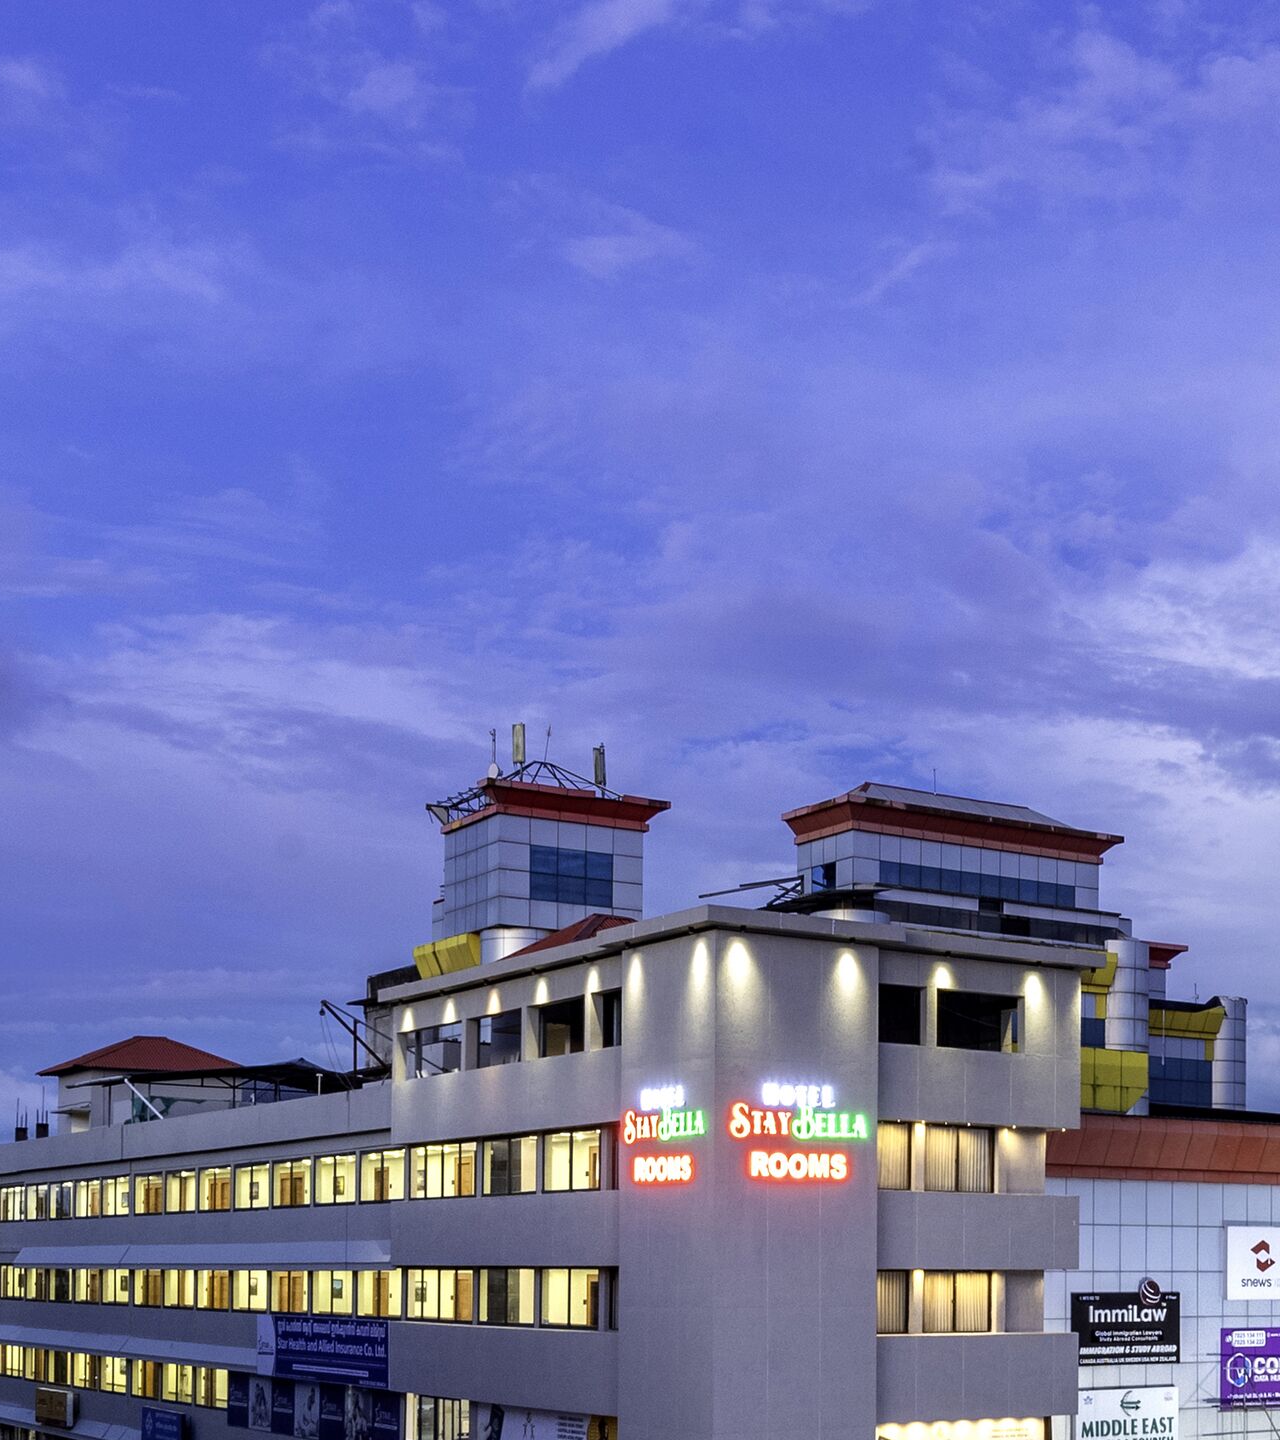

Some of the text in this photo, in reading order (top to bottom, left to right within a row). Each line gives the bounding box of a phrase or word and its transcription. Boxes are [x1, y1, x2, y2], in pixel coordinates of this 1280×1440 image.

[640, 1085, 686, 1111] HOTEL
[761, 1082, 836, 1108] HOTEL
[634, 1155, 692, 1182] ROOMS
[750, 1151, 847, 1180] ROOMS
[1241, 1278, 1272, 1287] snews
[1089, 1304, 1167, 1323] ImmiLaw
[288, 1338, 306, 1351] Health
[307, 1339, 317, 1352] and
[318, 1340, 335, 1353] Allied
[335, 1341, 363, 1356] Insurance
[364, 1344, 374, 1357] Co.
[1080, 1346, 1125, 1355] IMMIGRATION
[1131, 1345, 1151, 1353] STUDY
[1151, 1345, 1177, 1353] ABROAD
[1081, 1417, 1174, 1438] MIDDLE EAST
